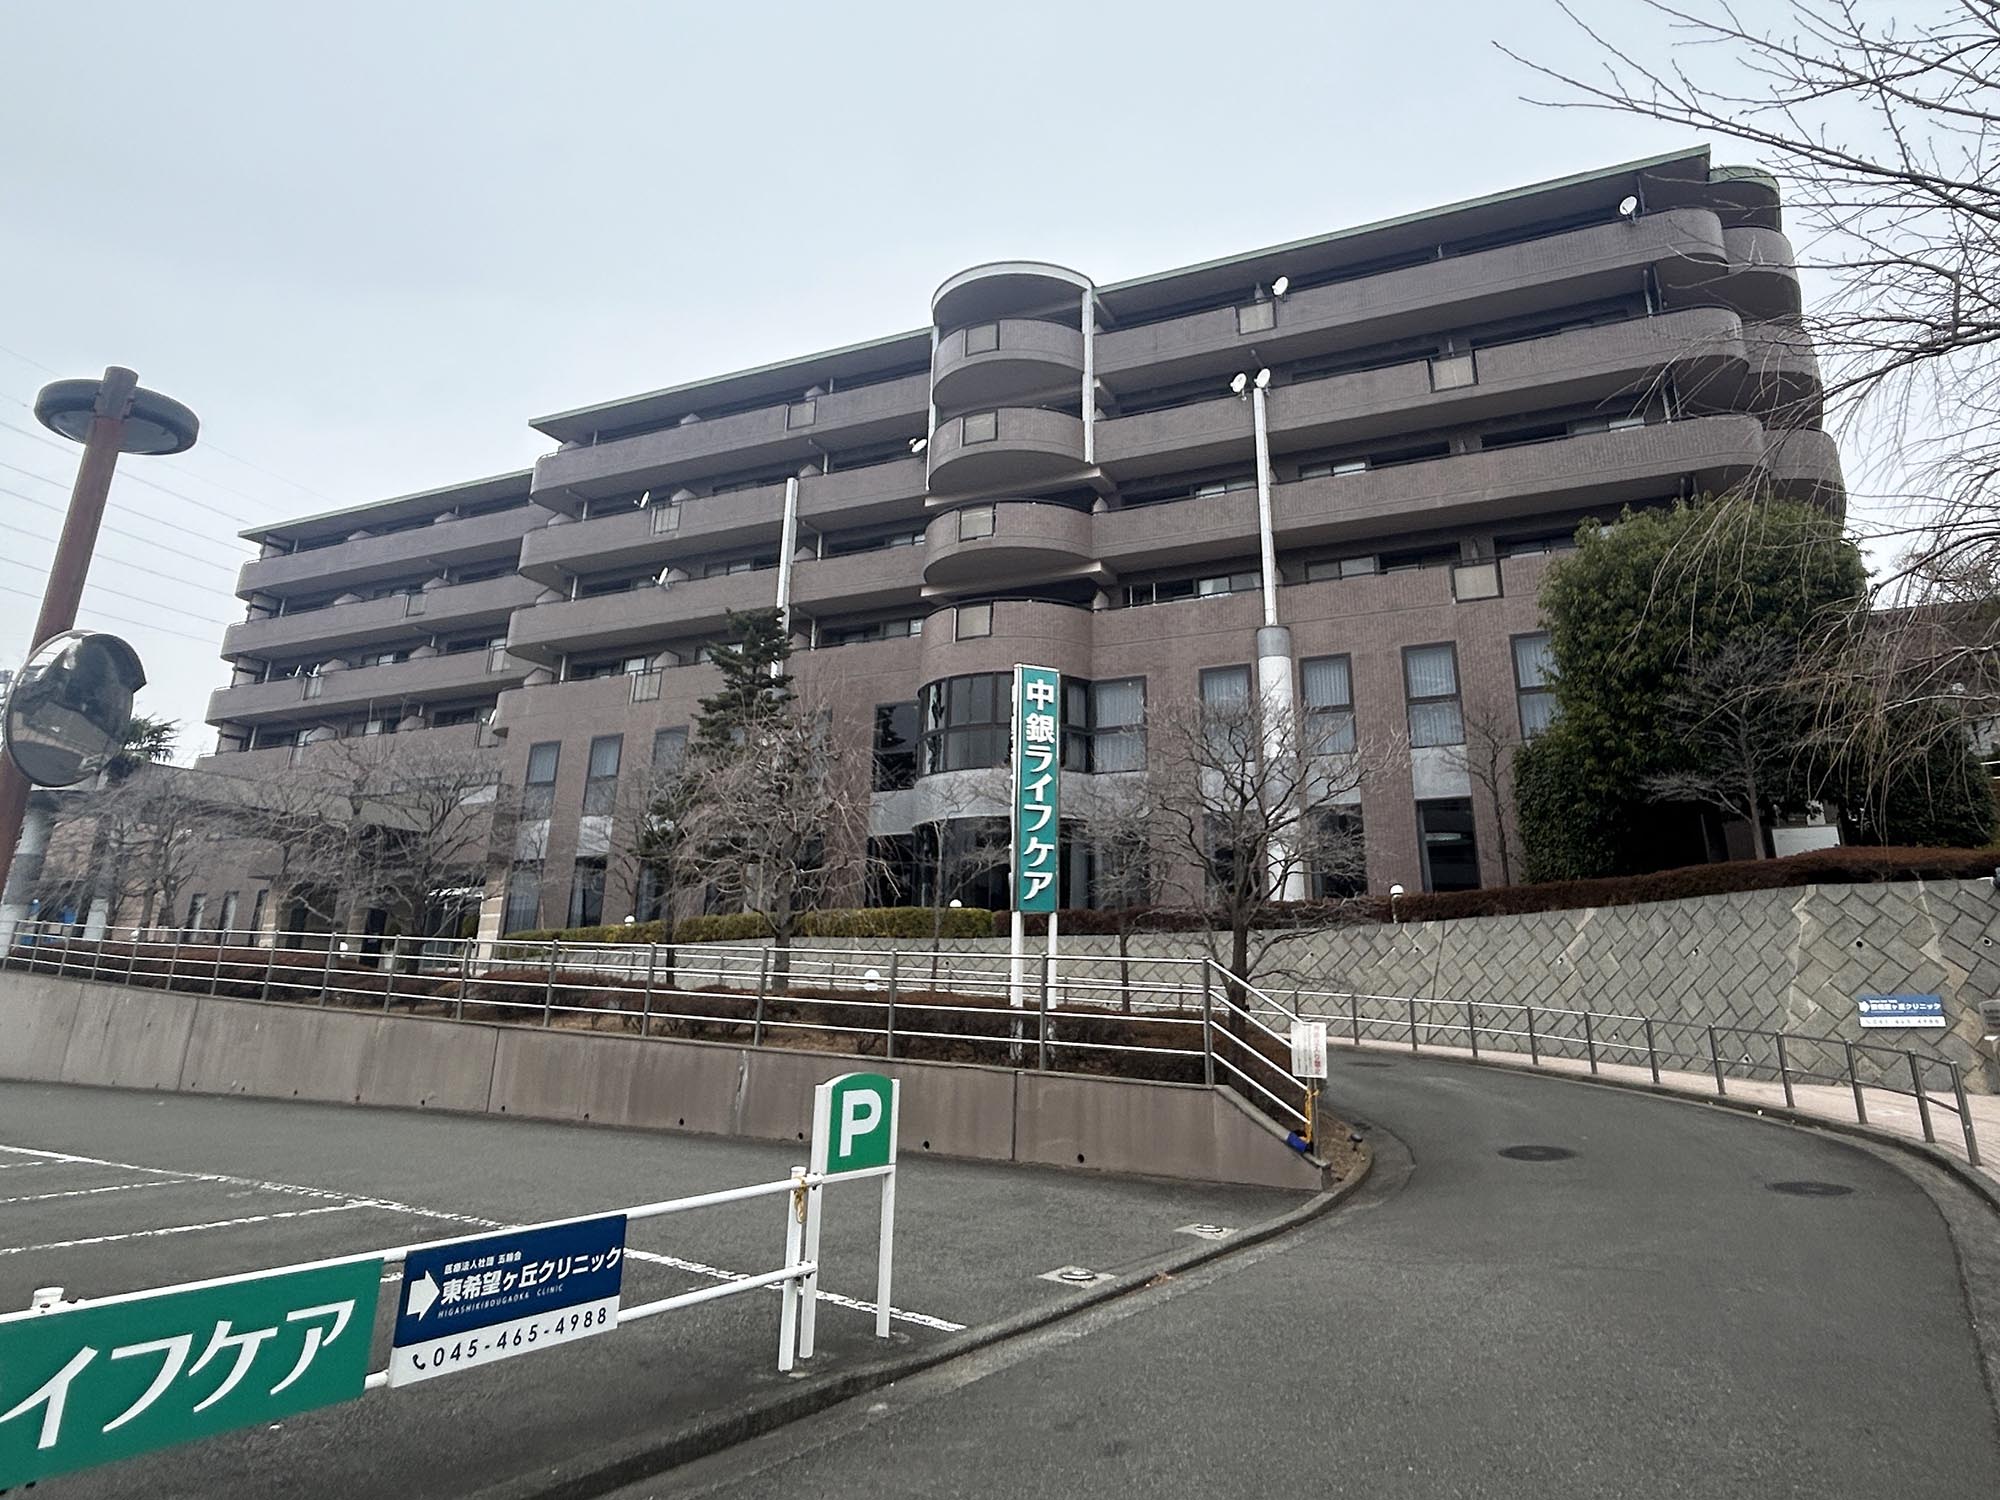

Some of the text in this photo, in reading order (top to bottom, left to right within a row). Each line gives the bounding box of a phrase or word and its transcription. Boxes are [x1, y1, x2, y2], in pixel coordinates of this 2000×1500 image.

[1023, 679, 1056, 900] 中銀ライフケア
[839, 1089, 882, 1157] P
[440, 1247, 622, 1305] 東希望ヶ丘クリニック
[433, 1307, 606, 1367] 045-465-4988
[0, 1299, 356, 1450] イフケア
